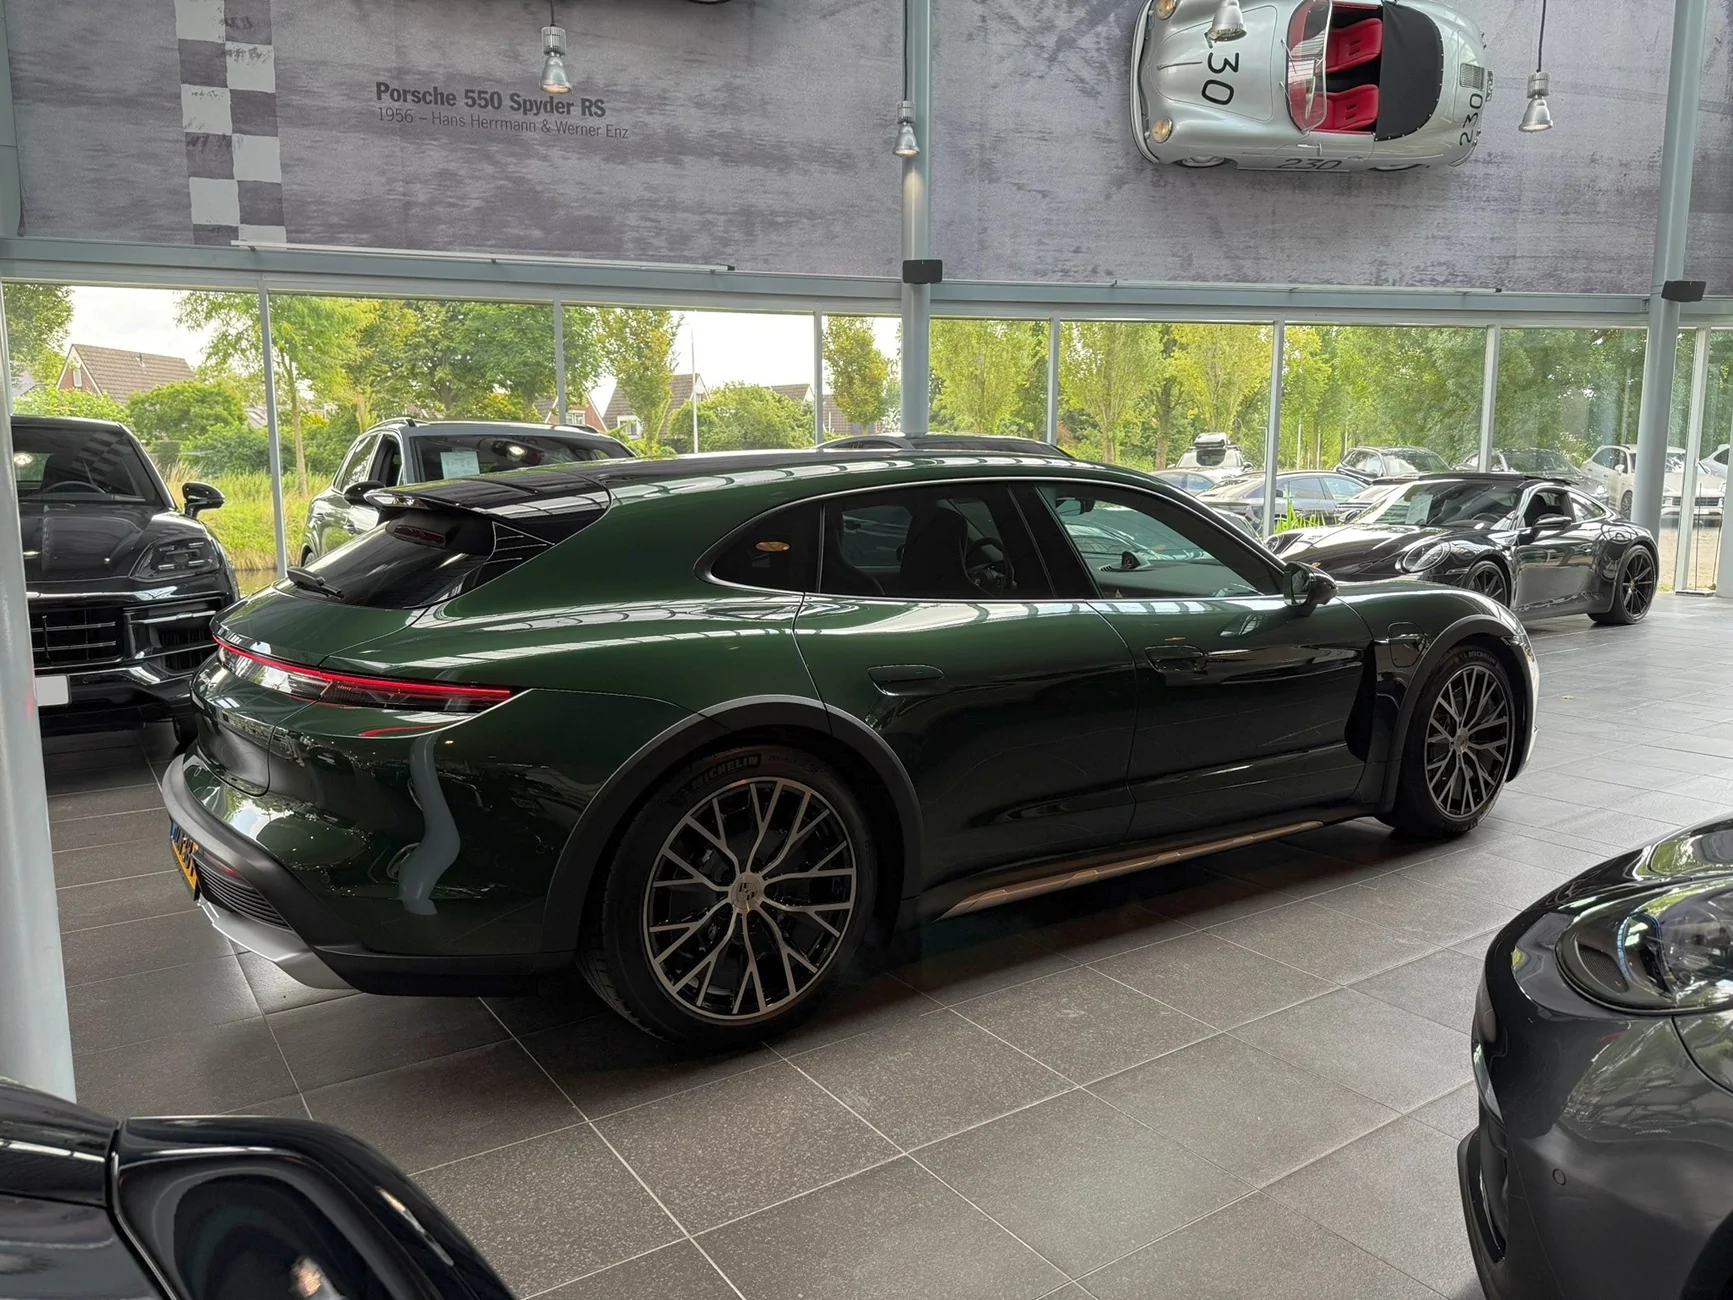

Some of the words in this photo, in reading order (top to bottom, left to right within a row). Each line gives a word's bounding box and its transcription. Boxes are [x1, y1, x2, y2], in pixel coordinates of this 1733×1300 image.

[375, 81, 457, 106] Porsche
[464, 89, 502, 110] 550
[509, 92, 575, 116] Spyder
[581, 98, 606, 118] RS
[378, 107, 414, 124] 1956
[432, 111, 466, 128] Hans
[471, 114, 536, 133] Herrmann
[541, 118, 551, 134] &
[555, 120, 601, 137] Werner
[606, 124, 629, 139] Enz
[1459, 92, 1484, 147] 230
[1276, 158, 1342, 170] 230
[691, 755, 760, 788] MICHELIN
